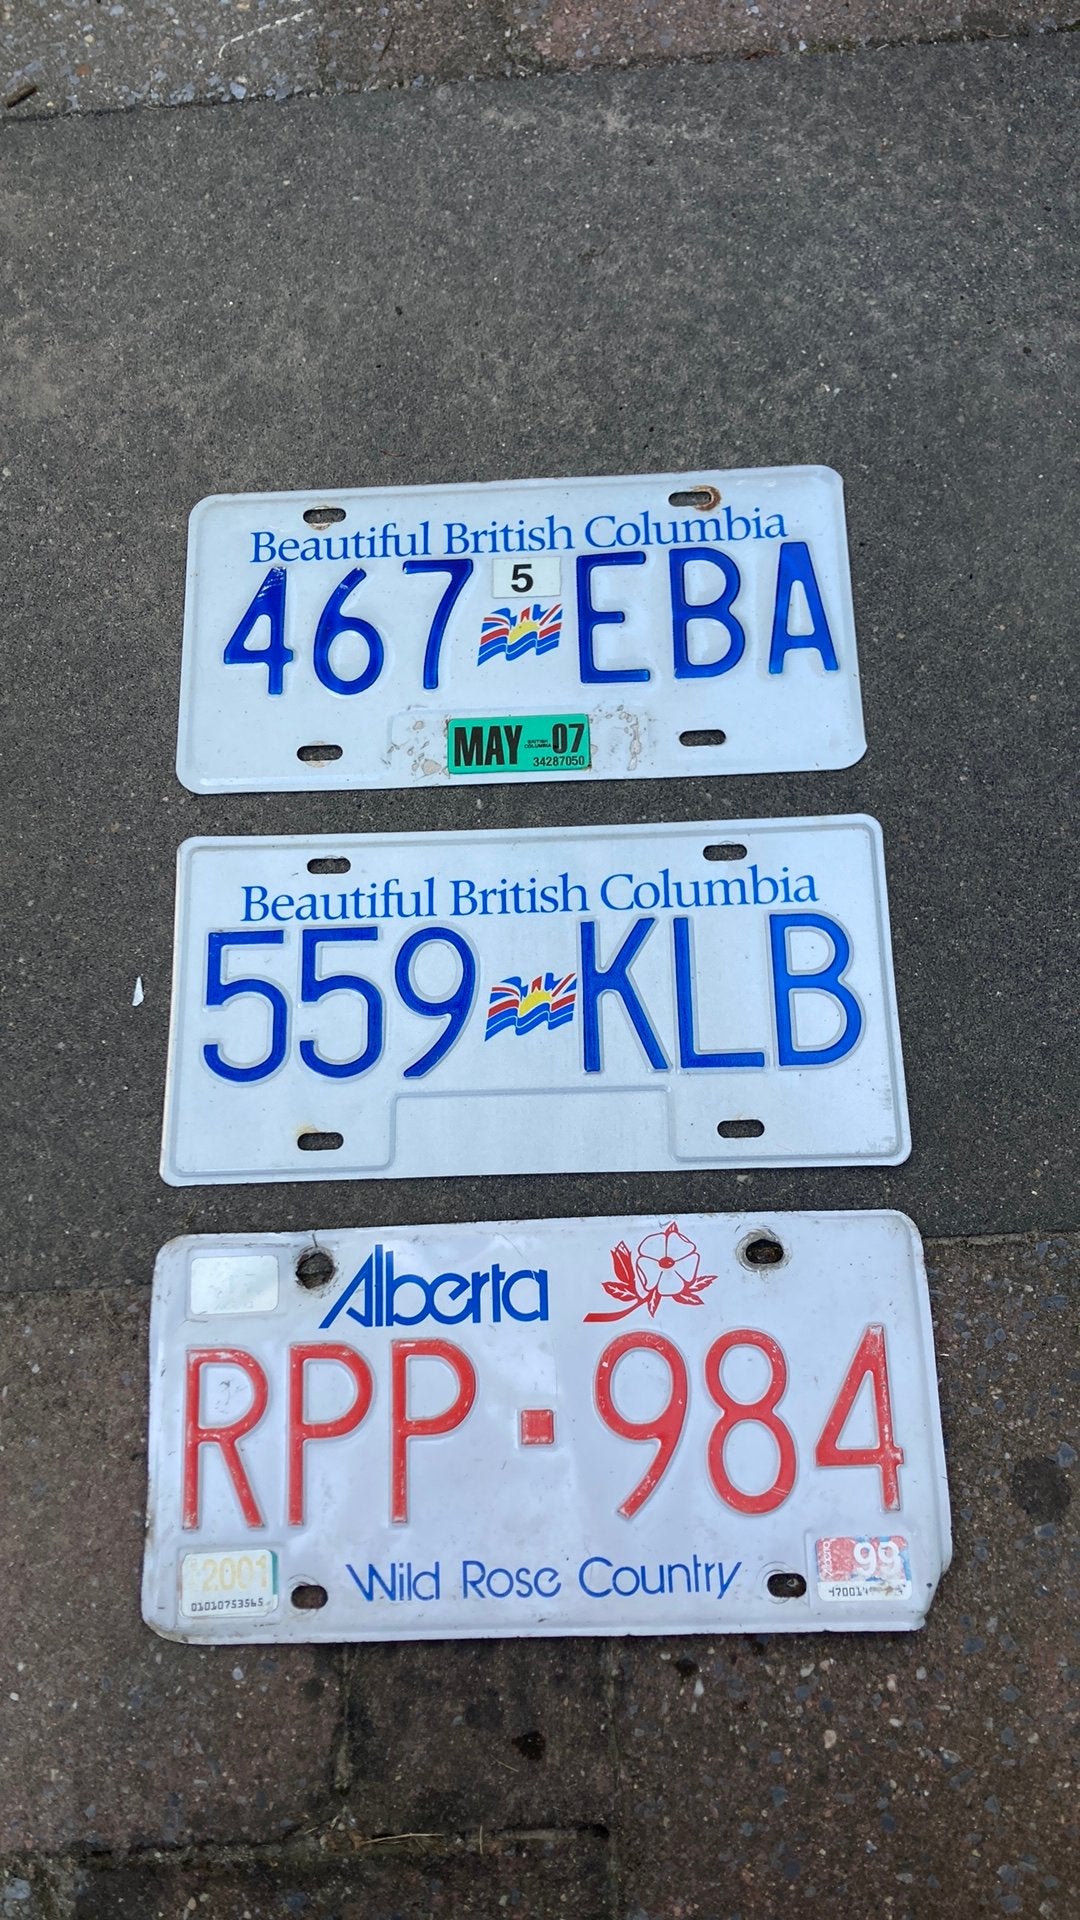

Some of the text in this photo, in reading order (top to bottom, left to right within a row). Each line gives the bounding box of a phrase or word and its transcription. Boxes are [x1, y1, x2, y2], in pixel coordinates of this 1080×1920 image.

[250, 505, 789, 564] Beautiful British Columbia
[510, 563, 534, 593] 5
[222, 540, 840, 696] 467 EBA
[454, 723, 585, 767] MAY 07
[533, 755, 586, 767] 34287050
[241, 864, 819, 922] Beautiful British Columbia
[202, 912, 863, 1084] 559 KLB
[318, 1244, 550, 1330] Alberta
[183, 1325, 904, 1528] RPP 984
[202, 1554, 268, 1592] 2001
[346, 1554, 742, 1602] Wild Rose Country
[853, 1540, 904, 1578] 99
